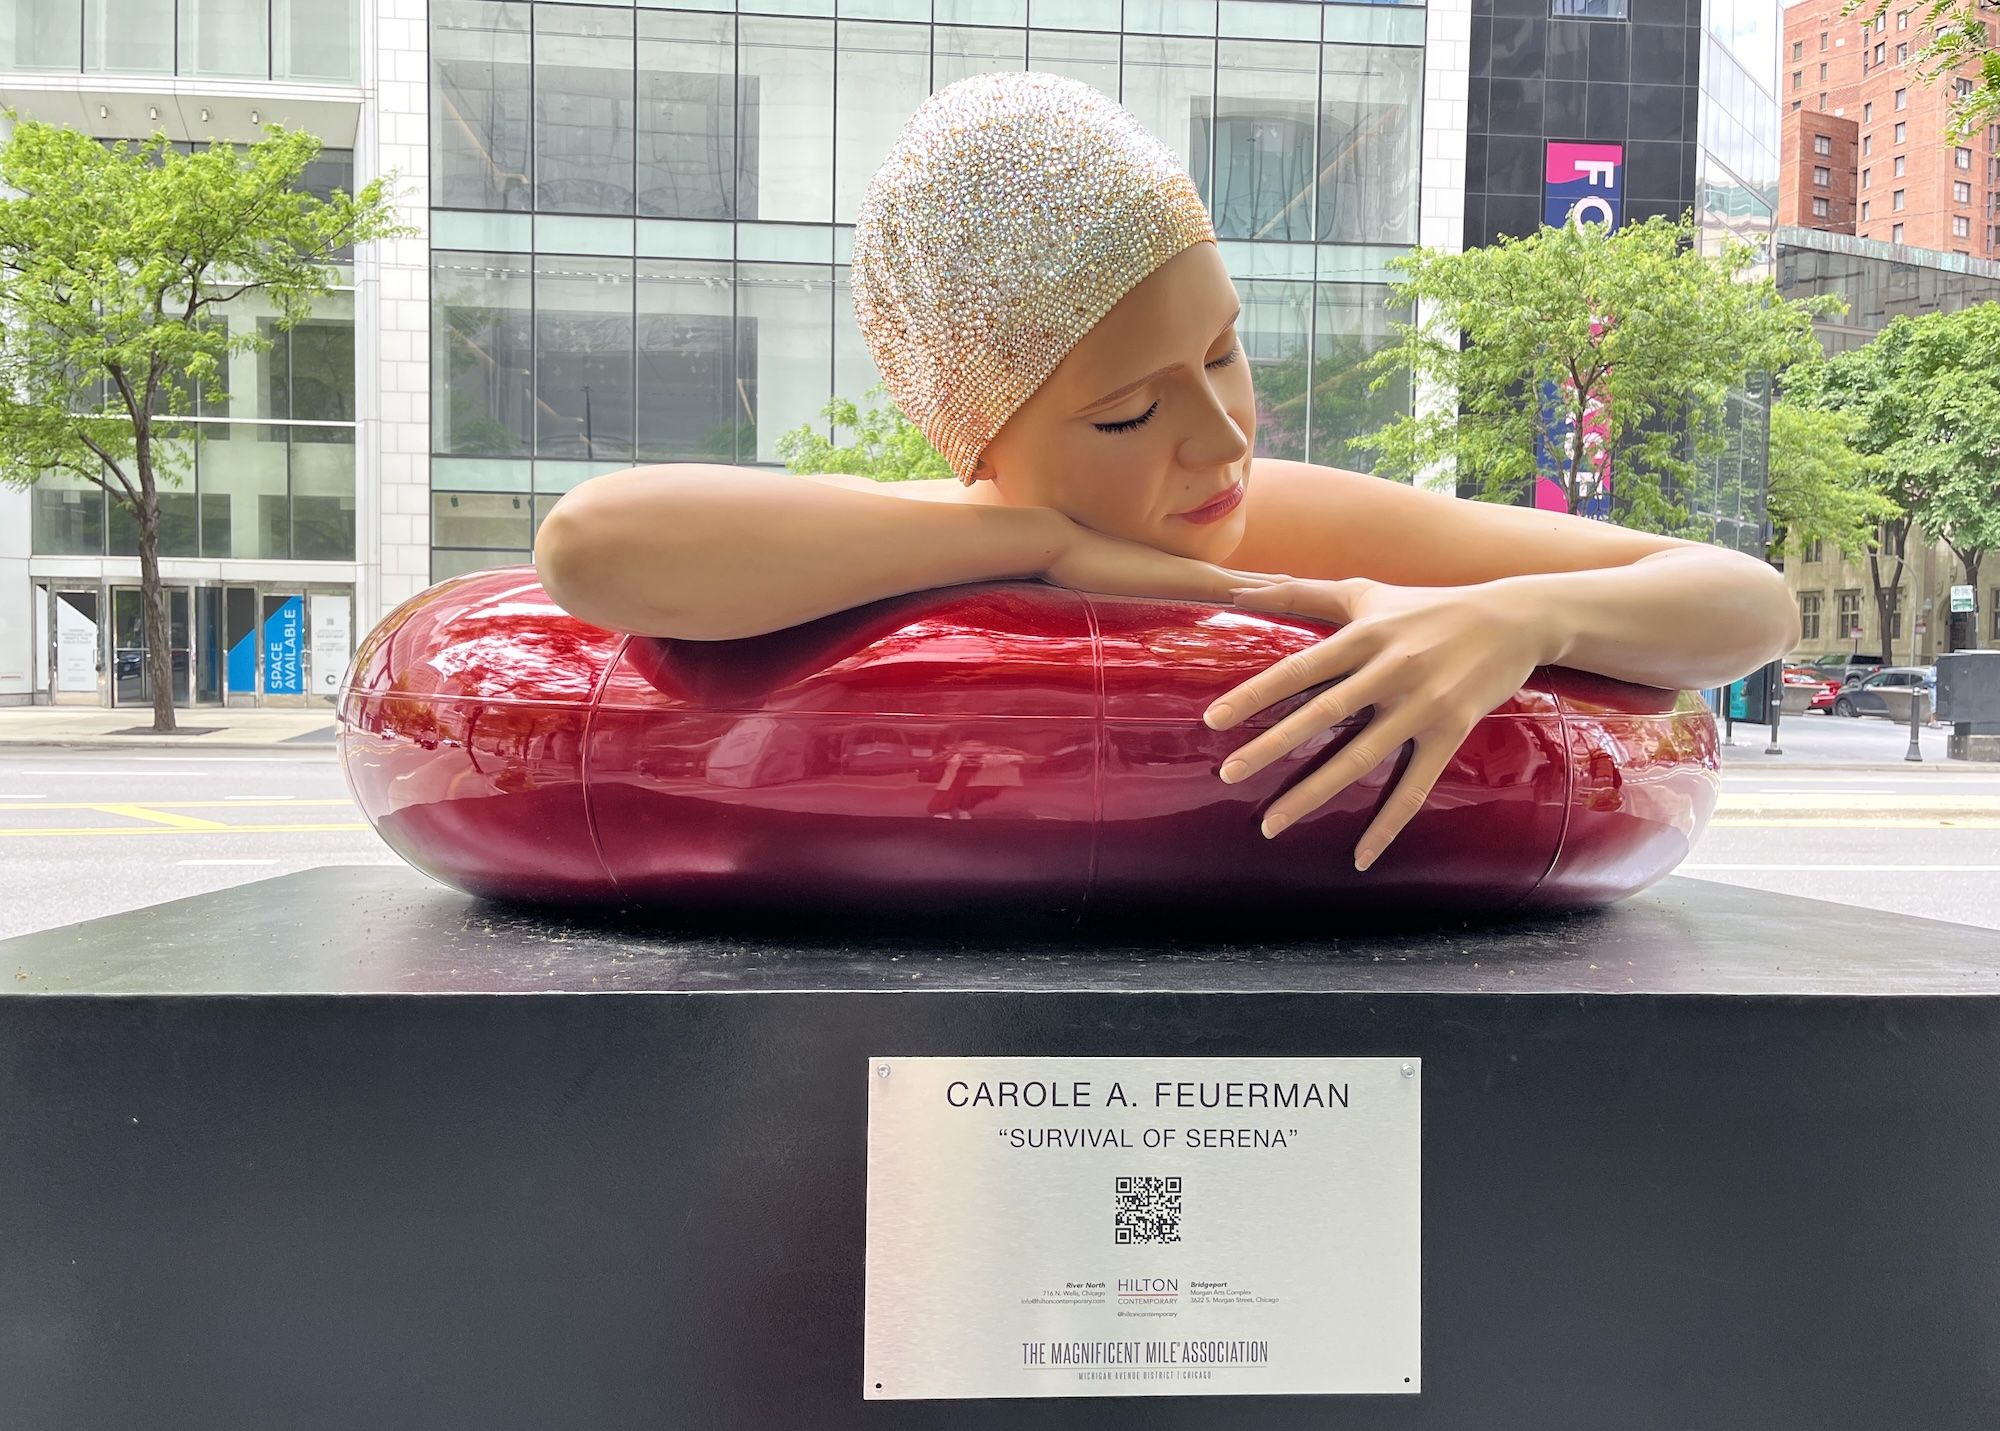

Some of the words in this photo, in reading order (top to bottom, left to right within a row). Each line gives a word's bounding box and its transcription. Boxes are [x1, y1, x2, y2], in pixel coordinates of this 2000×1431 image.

[284, 609, 296, 689] AVAILABLE
[271, 641, 283, 689] SPACE
[946, 1081, 1091, 1108] CAROLE
[1106, 1081, 1138, 1108] A.
[1155, 1082, 1350, 1108] FEUERMAN
[999, 1128, 1134, 1148] “SURVIVAL
[1143, 1128, 1177, 1148] OF
[1186, 1128, 1299, 1148] SERENA”
[1081, 1290, 1106, 1298] Chicago
[1118, 1278, 1178, 1292] HILTON
[1190, 1281, 1228, 1289] Bridgeport
[1021, 1342, 1046, 1365] THE
[1051, 1342, 1141, 1365] MAGNIFICENT
[1181, 1340, 1268, 1364] ASSOCIATION
[1078, 1371, 1112, 1380] MICHIGAN
[1114, 1371, 1140, 1380] AVENUE
[1142, 1371, 1174, 1380] DISTRICT
[1182, 1370, 1212, 1380] CHICAGO
